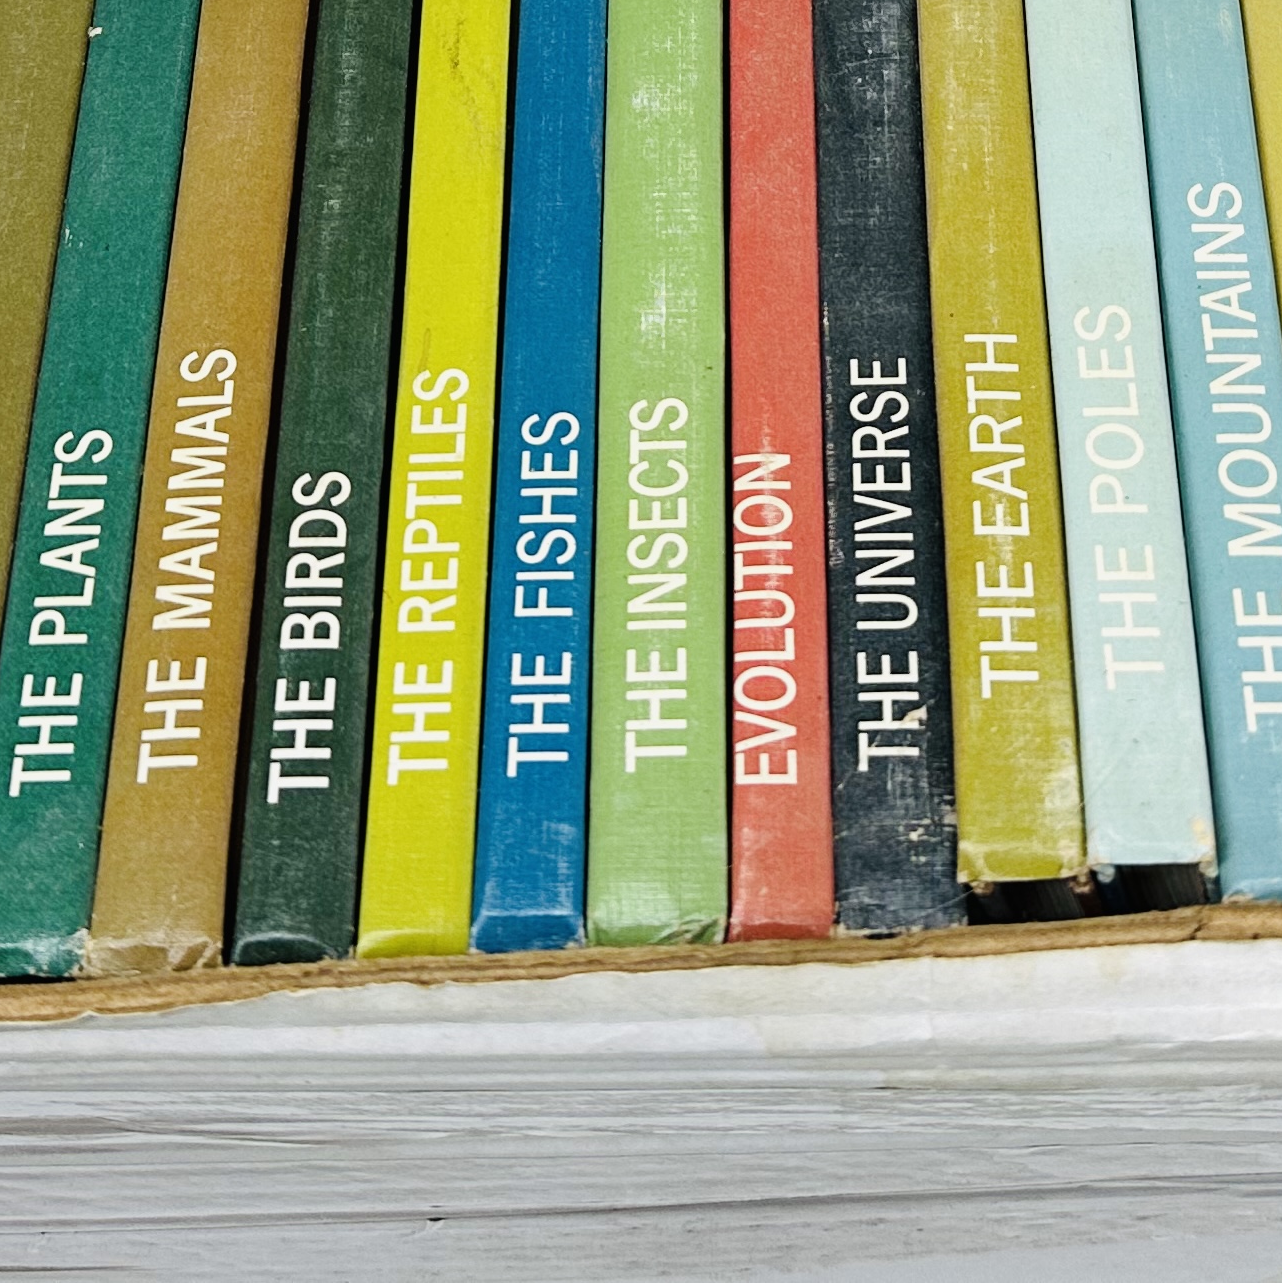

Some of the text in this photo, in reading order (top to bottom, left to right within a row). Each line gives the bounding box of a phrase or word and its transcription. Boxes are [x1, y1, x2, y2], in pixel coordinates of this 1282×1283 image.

[9, 429, 113, 797] THE PLANTS
[137, 348, 237, 784] THE MAMMALS
[267, 471, 351, 803] THE BIRDS
[387, 368, 469, 785] THE REPTILES
[506, 412, 580, 778] THE FISHES
[625, 397, 689, 772] THE INSECTS
[734, 453, 797, 785] EVOLUTION
[849, 357, 920, 772] THE UNIVERSE
[964, 333, 1039, 698] THE EARTH
[1074, 304, 1165, 690] THE POLES
